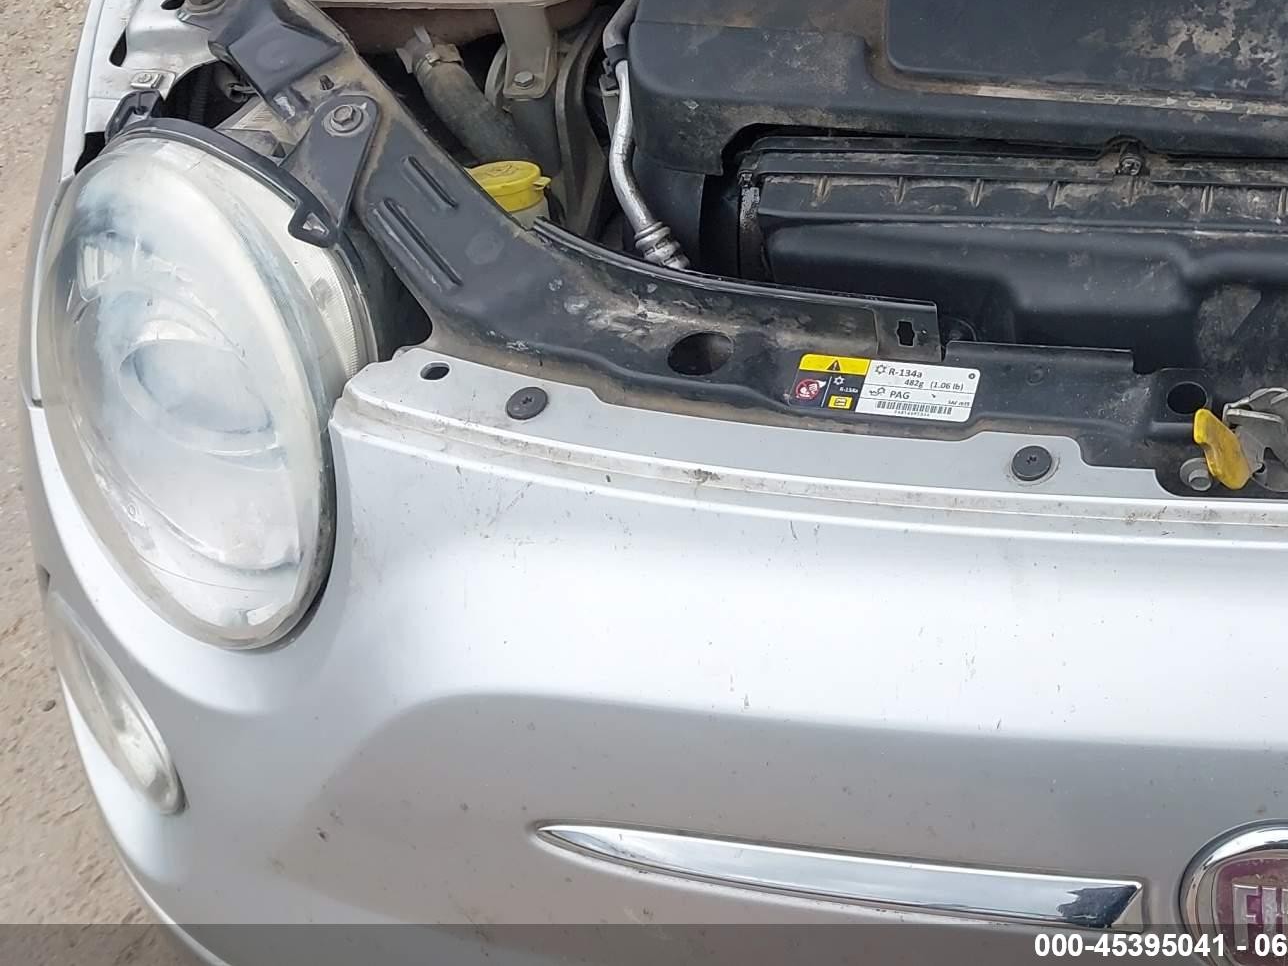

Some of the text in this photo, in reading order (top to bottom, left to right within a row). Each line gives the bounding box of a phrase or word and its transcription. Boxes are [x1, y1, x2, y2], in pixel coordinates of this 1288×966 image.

[888, 368, 923, 379] R-134a
[904, 379, 965, 391] 482g (1.06 lb)
[889, 391, 911, 400] PAG
